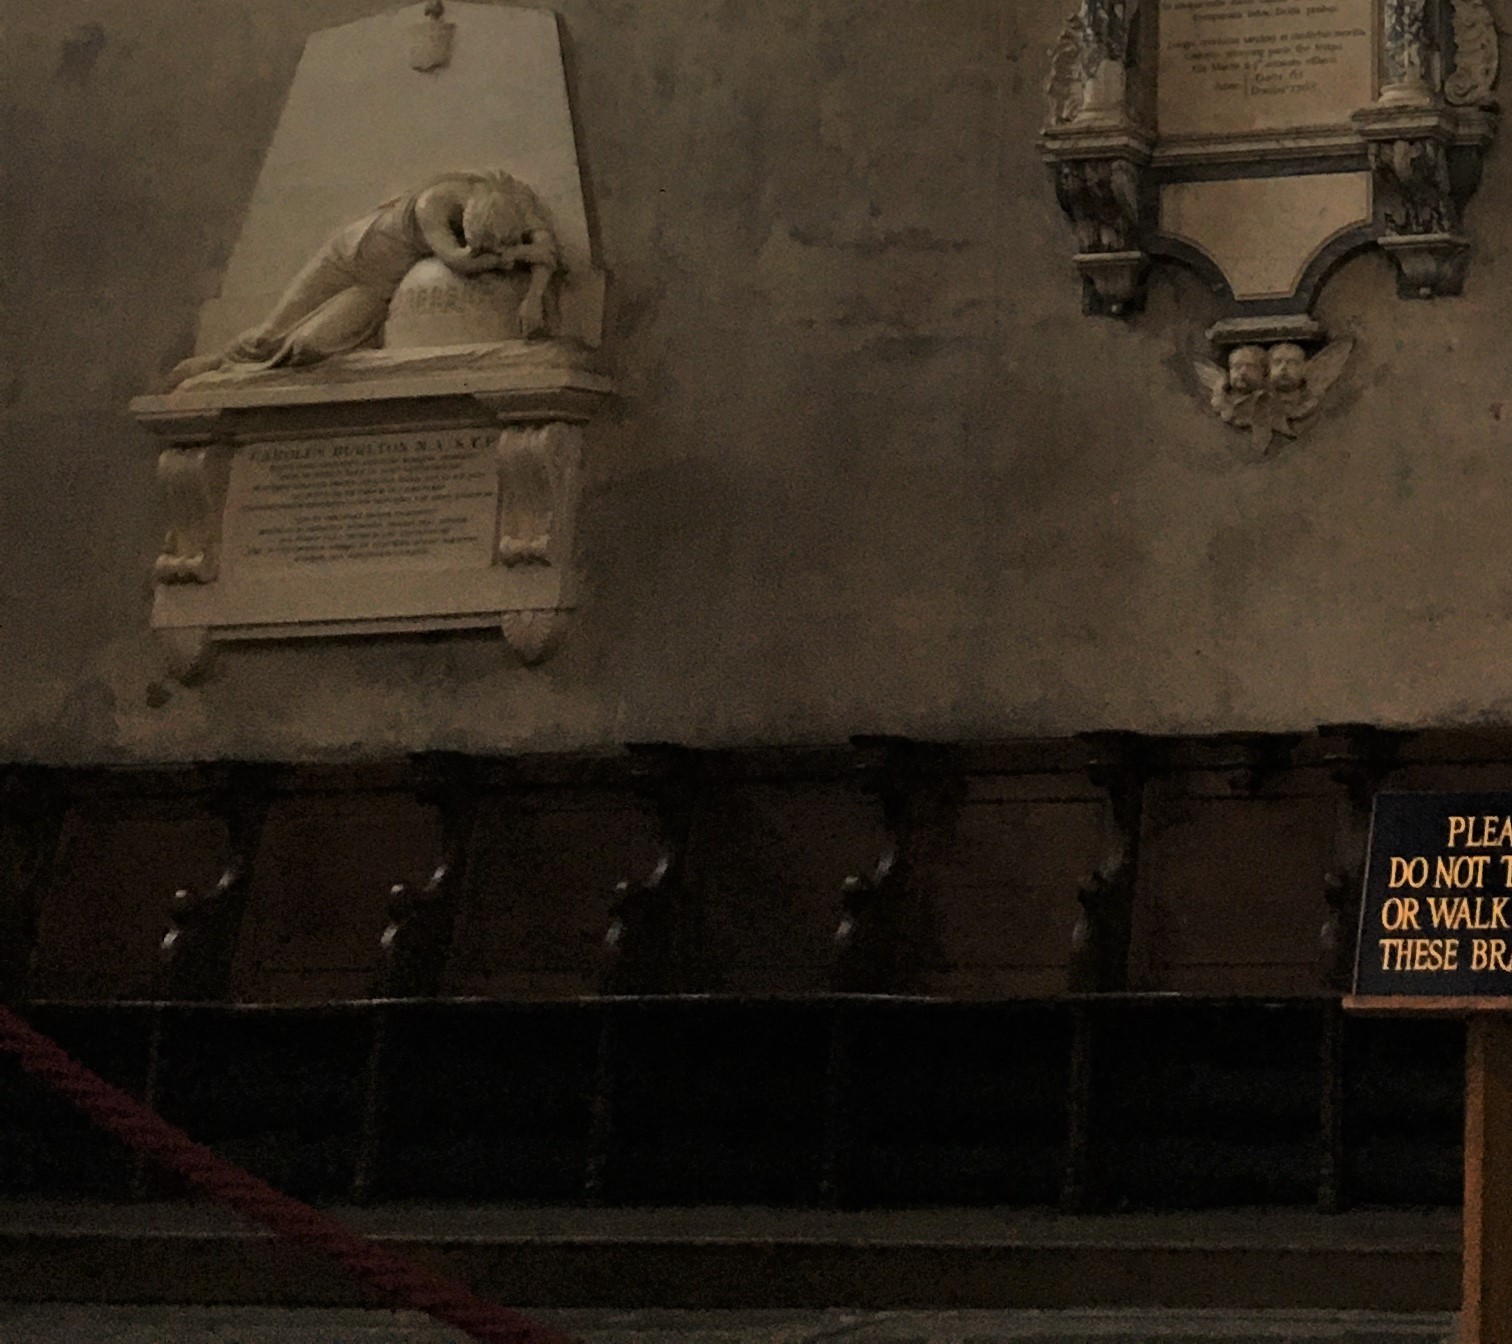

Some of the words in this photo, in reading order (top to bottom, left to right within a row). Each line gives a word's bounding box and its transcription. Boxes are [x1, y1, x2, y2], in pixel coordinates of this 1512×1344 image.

[1388, 856, 1429, 889] DO
[1433, 855, 1491, 889] NOT
[1381, 897, 1421, 931] OR
[1426, 896, 1511, 930] WALK
[1379, 938, 1460, 971] THESE
